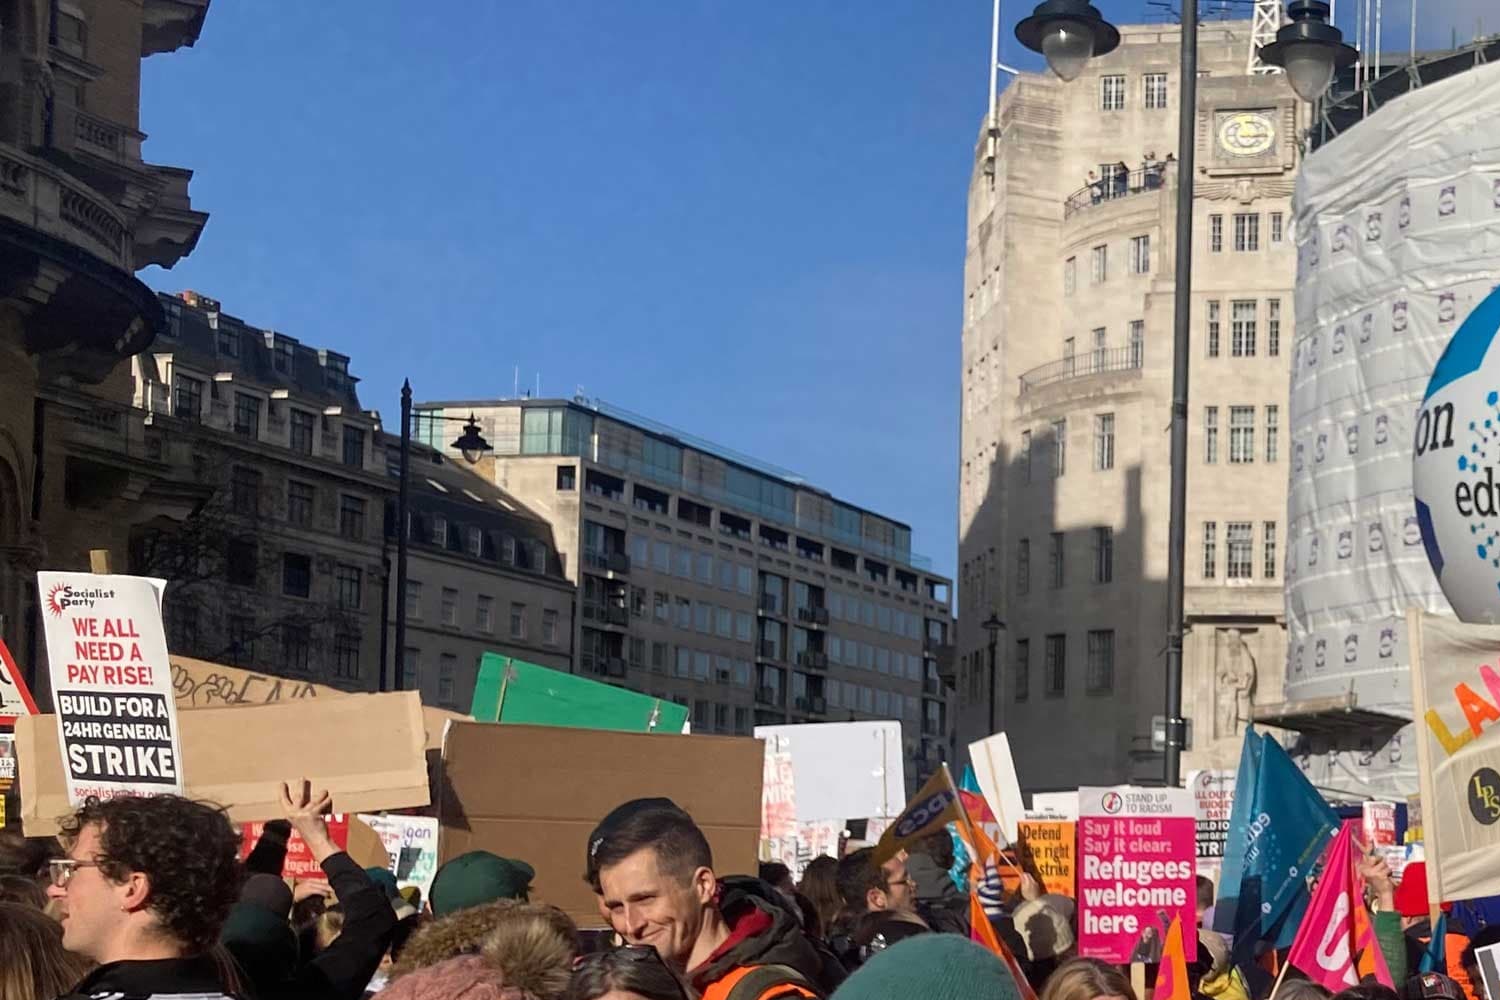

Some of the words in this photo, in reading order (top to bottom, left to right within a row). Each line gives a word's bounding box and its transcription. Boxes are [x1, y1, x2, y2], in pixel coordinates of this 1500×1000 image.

[63, 586, 116, 598] Socialist
[60, 598, 95, 609] Party
[72, 618, 99, 637] WE
[103, 618, 140, 637] ALL
[75, 641, 124, 661] NEED
[130, 642, 143, 661] A
[67, 664, 99, 683] PAY
[103, 666, 154, 685] RISE!
[60, 696, 112, 716] BUILD
[115, 697, 154, 717] FOR
[157, 698, 168, 718] A
[63, 722, 102, 738] 24HR
[103, 723, 171, 741] GENERAL
[69, 743, 175, 778] STRIKE
[1125, 793, 1151, 803] STAND
[1154, 793, 1168, 803] UP
[1125, 803, 1137, 813] TO
[1139, 803, 1172, 813] RACISM
[1024, 825, 1062, 840] Defend
[1084, 820, 1110, 839] Say
[1114, 820, 1126, 836] it
[1129, 820, 1162, 836] loud
[1044, 844, 1069, 864] right
[1083, 837, 1110, 856] Say
[1114, 838, 1126, 853] it
[1129, 838, 1172, 853] clear:
[1040, 863, 1069, 877] strike
[1084, 854, 1192, 885] Refugees
[1084, 883, 1186, 907] welcome
[1084, 909, 1139, 934] here
